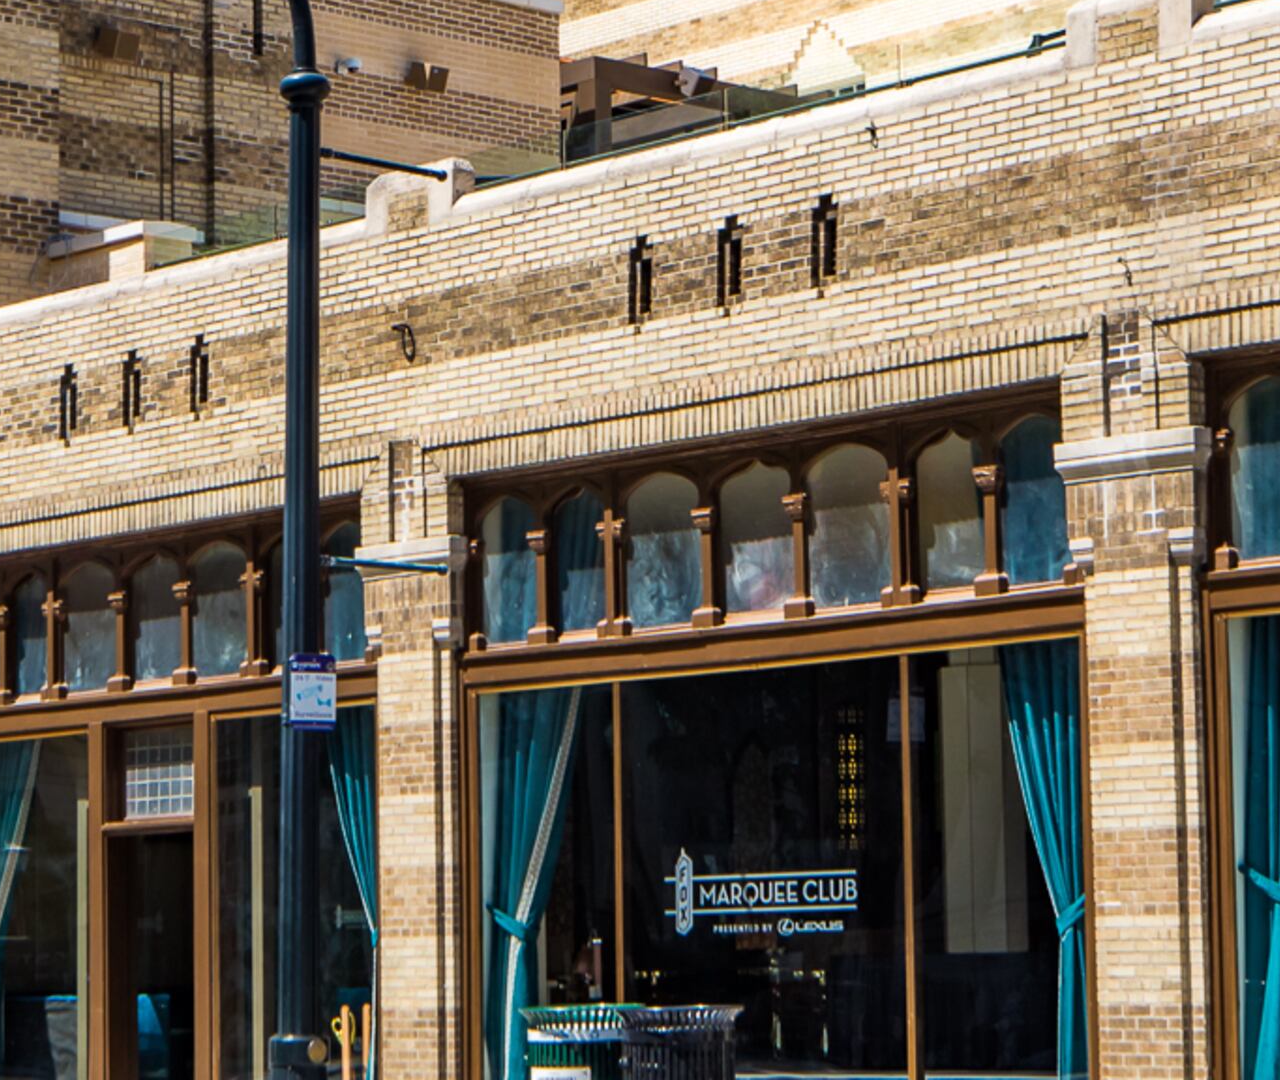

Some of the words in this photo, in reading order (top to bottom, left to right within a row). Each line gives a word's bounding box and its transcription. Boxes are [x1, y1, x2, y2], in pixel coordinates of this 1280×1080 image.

[678, 865, 689, 922] FOX
[699, 880, 798, 907] MARQUEE
[802, 878, 858, 902] CLUB
